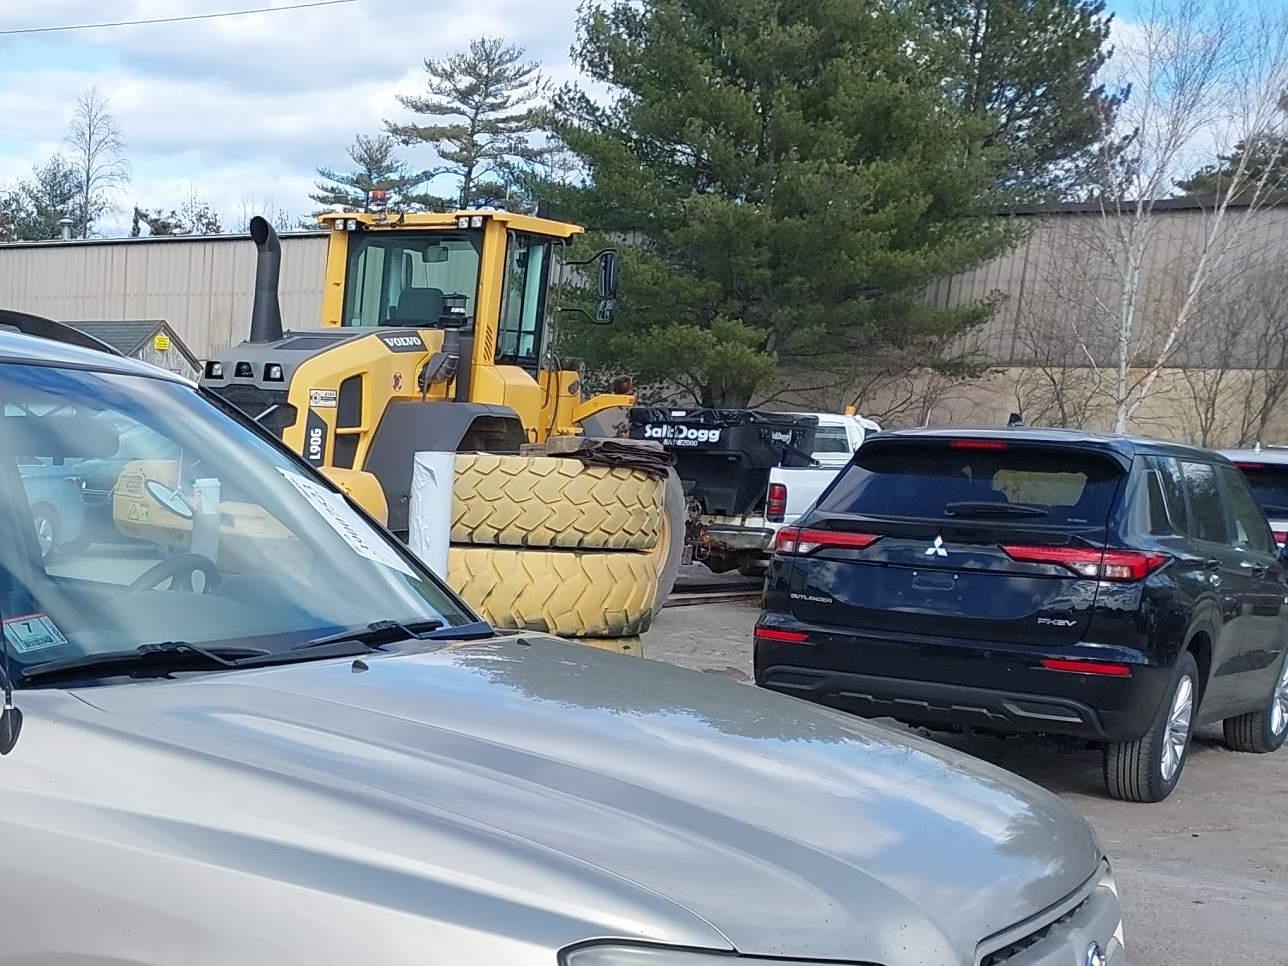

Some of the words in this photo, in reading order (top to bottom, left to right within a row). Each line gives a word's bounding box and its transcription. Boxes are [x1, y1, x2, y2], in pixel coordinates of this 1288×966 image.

[383, 336, 422, 347] VOLVO
[309, 428, 322, 460] L90G
[790, 593, 833, 604] OUTLANDER
[21, 622, 33, 634] 7
